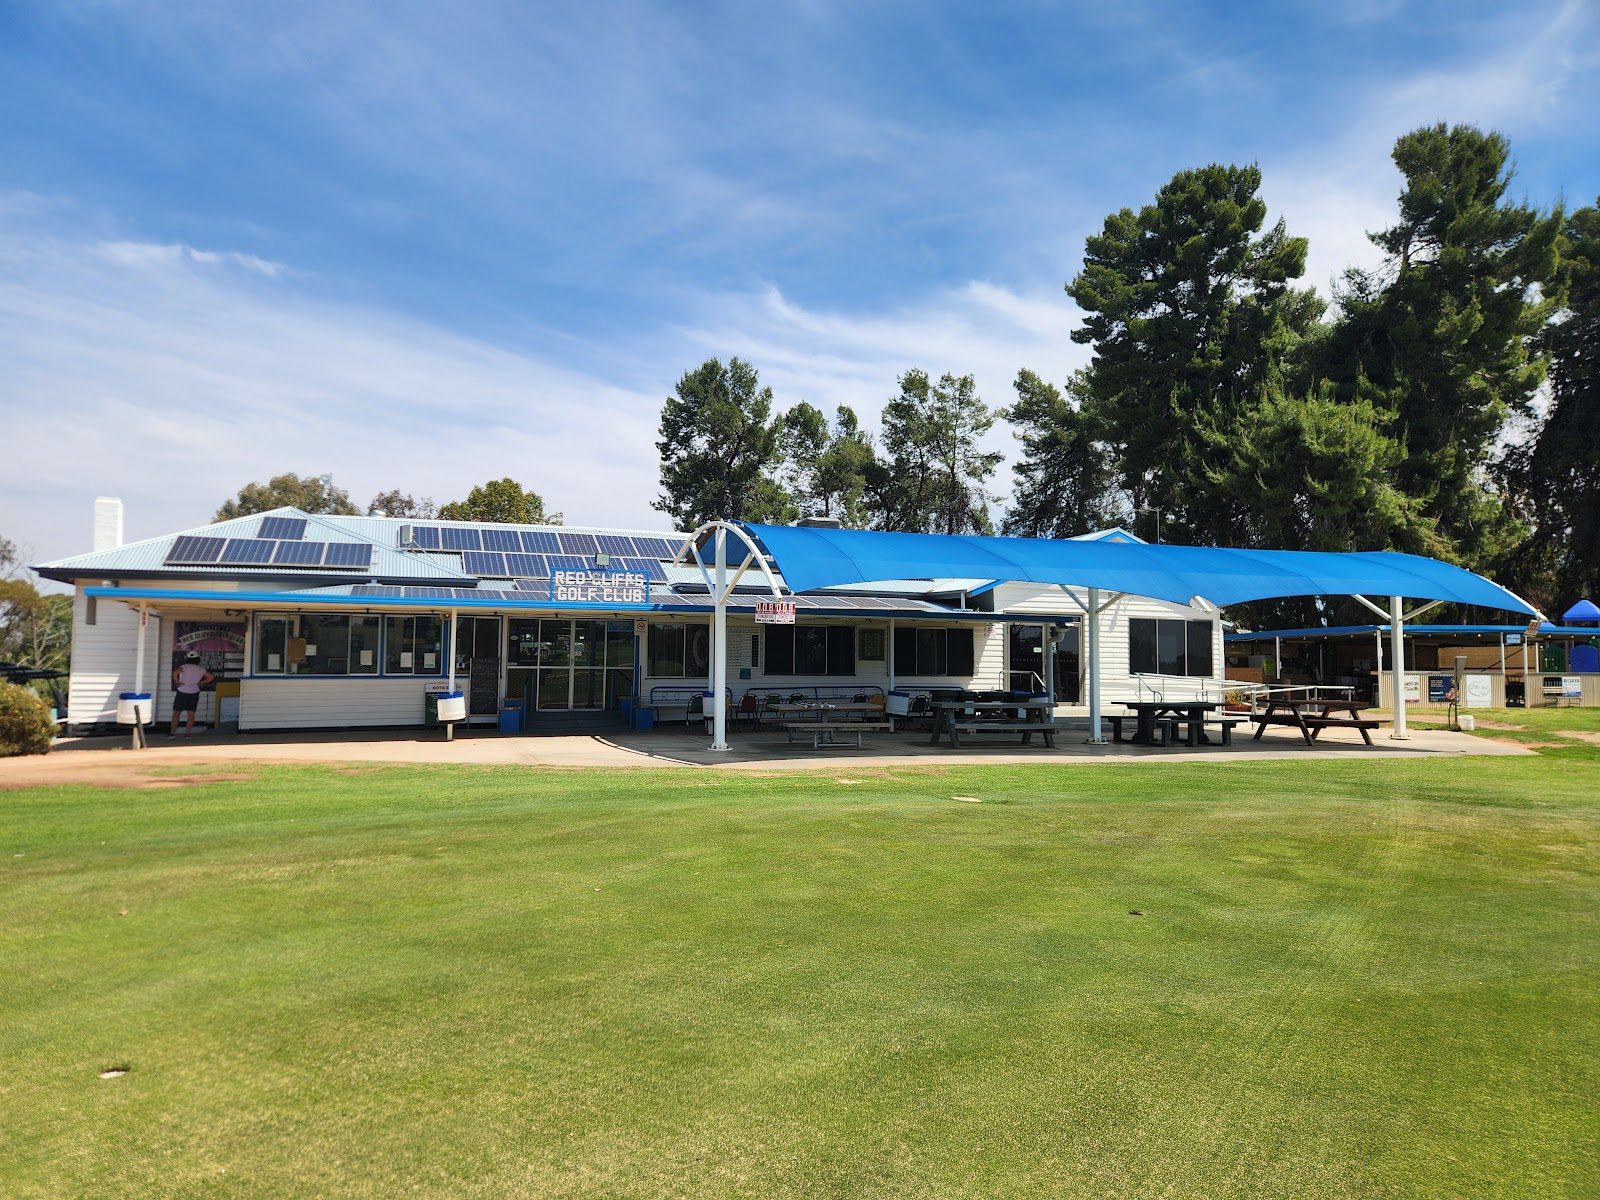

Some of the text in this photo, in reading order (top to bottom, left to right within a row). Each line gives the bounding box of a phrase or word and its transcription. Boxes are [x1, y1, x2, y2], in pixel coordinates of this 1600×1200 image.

[555, 571, 644, 587] RED CLIFFS
[557, 587, 642, 602] GOLF CLUB
